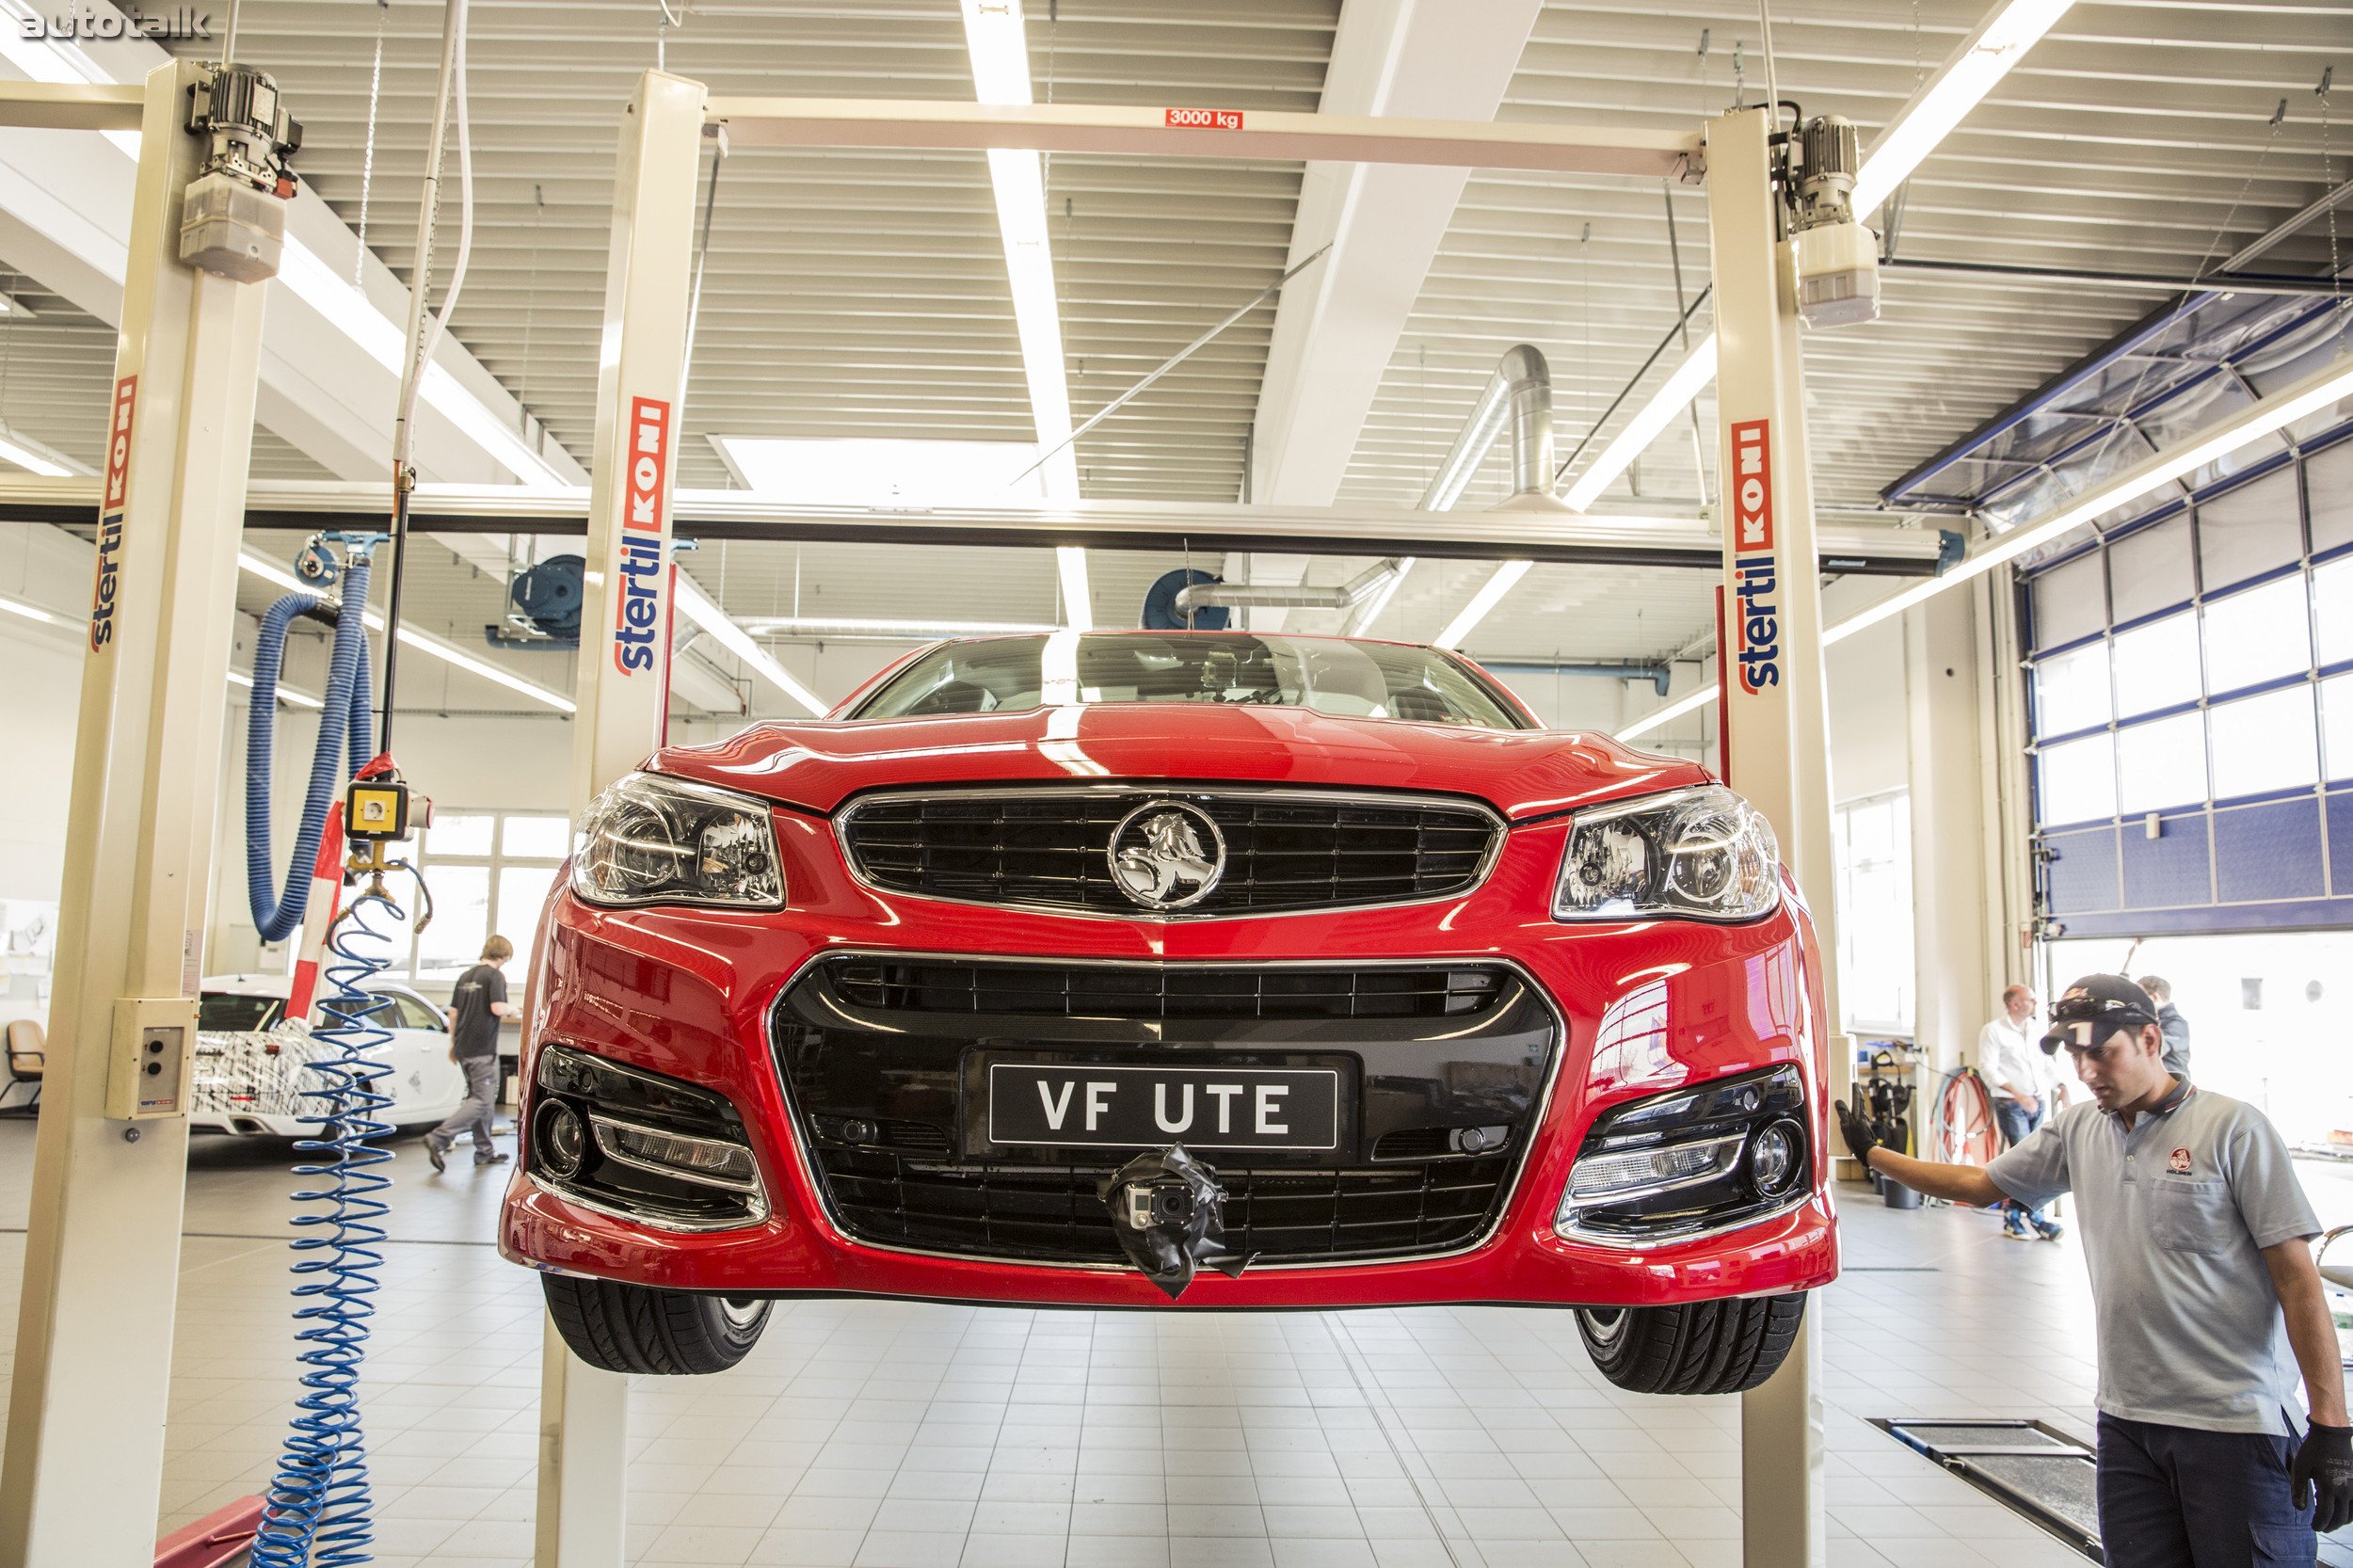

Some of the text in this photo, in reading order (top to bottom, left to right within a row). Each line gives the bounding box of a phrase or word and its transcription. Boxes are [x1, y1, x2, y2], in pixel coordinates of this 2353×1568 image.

[1170, 110, 1238, 129] 3000 kg
[91, 384, 132, 653] stertil KONI
[616, 406, 662, 676] stertil KONI
[1735, 428, 1779, 695] stertil KONI
[1037, 1081, 1289, 1134] VF UTE
[2068, 1021, 2093, 1047] 1
